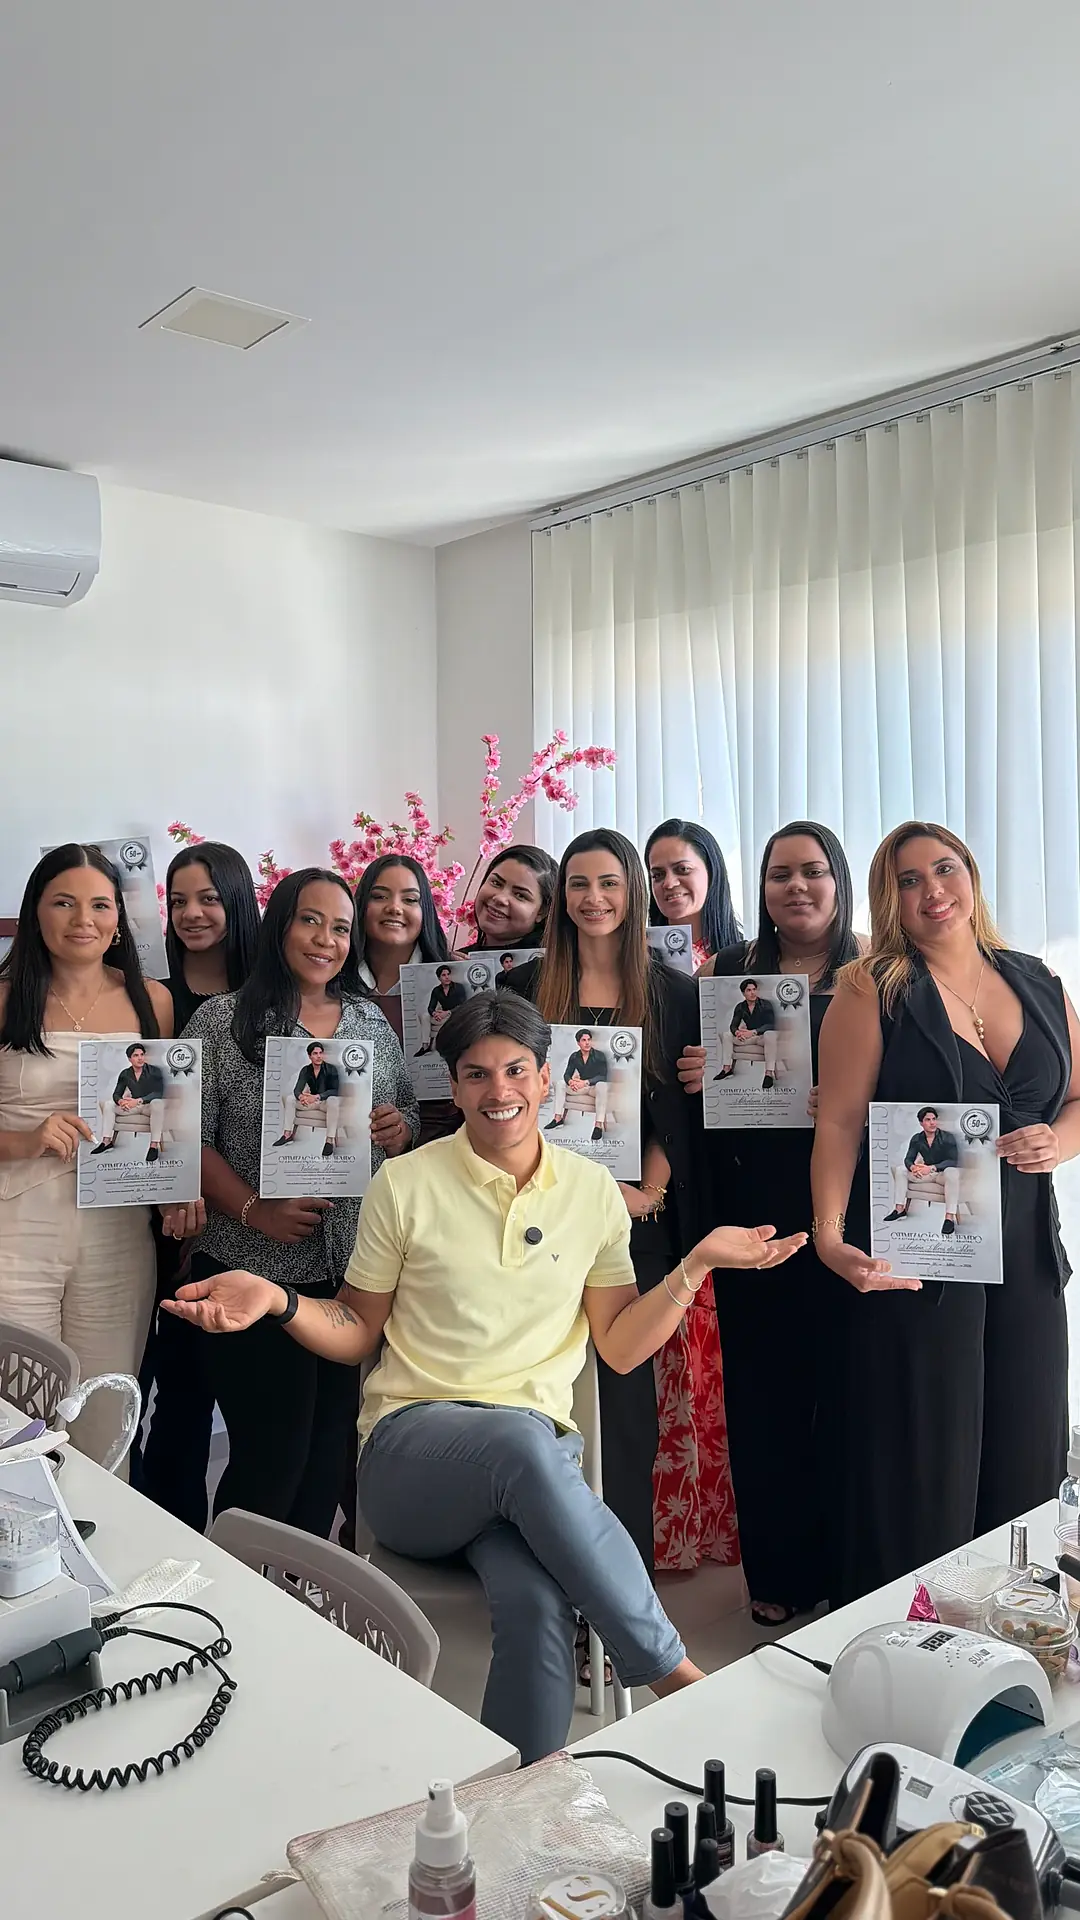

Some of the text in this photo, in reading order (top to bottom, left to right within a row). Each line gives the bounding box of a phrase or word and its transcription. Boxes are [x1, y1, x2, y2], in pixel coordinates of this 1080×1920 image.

[176, 1053, 185, 1061] 50
[262, 1040, 282, 1195] CERTIFICADO
[971, 1119, 981, 1128] 50
[871, 1106, 890, 1260] CERTIFICAD
